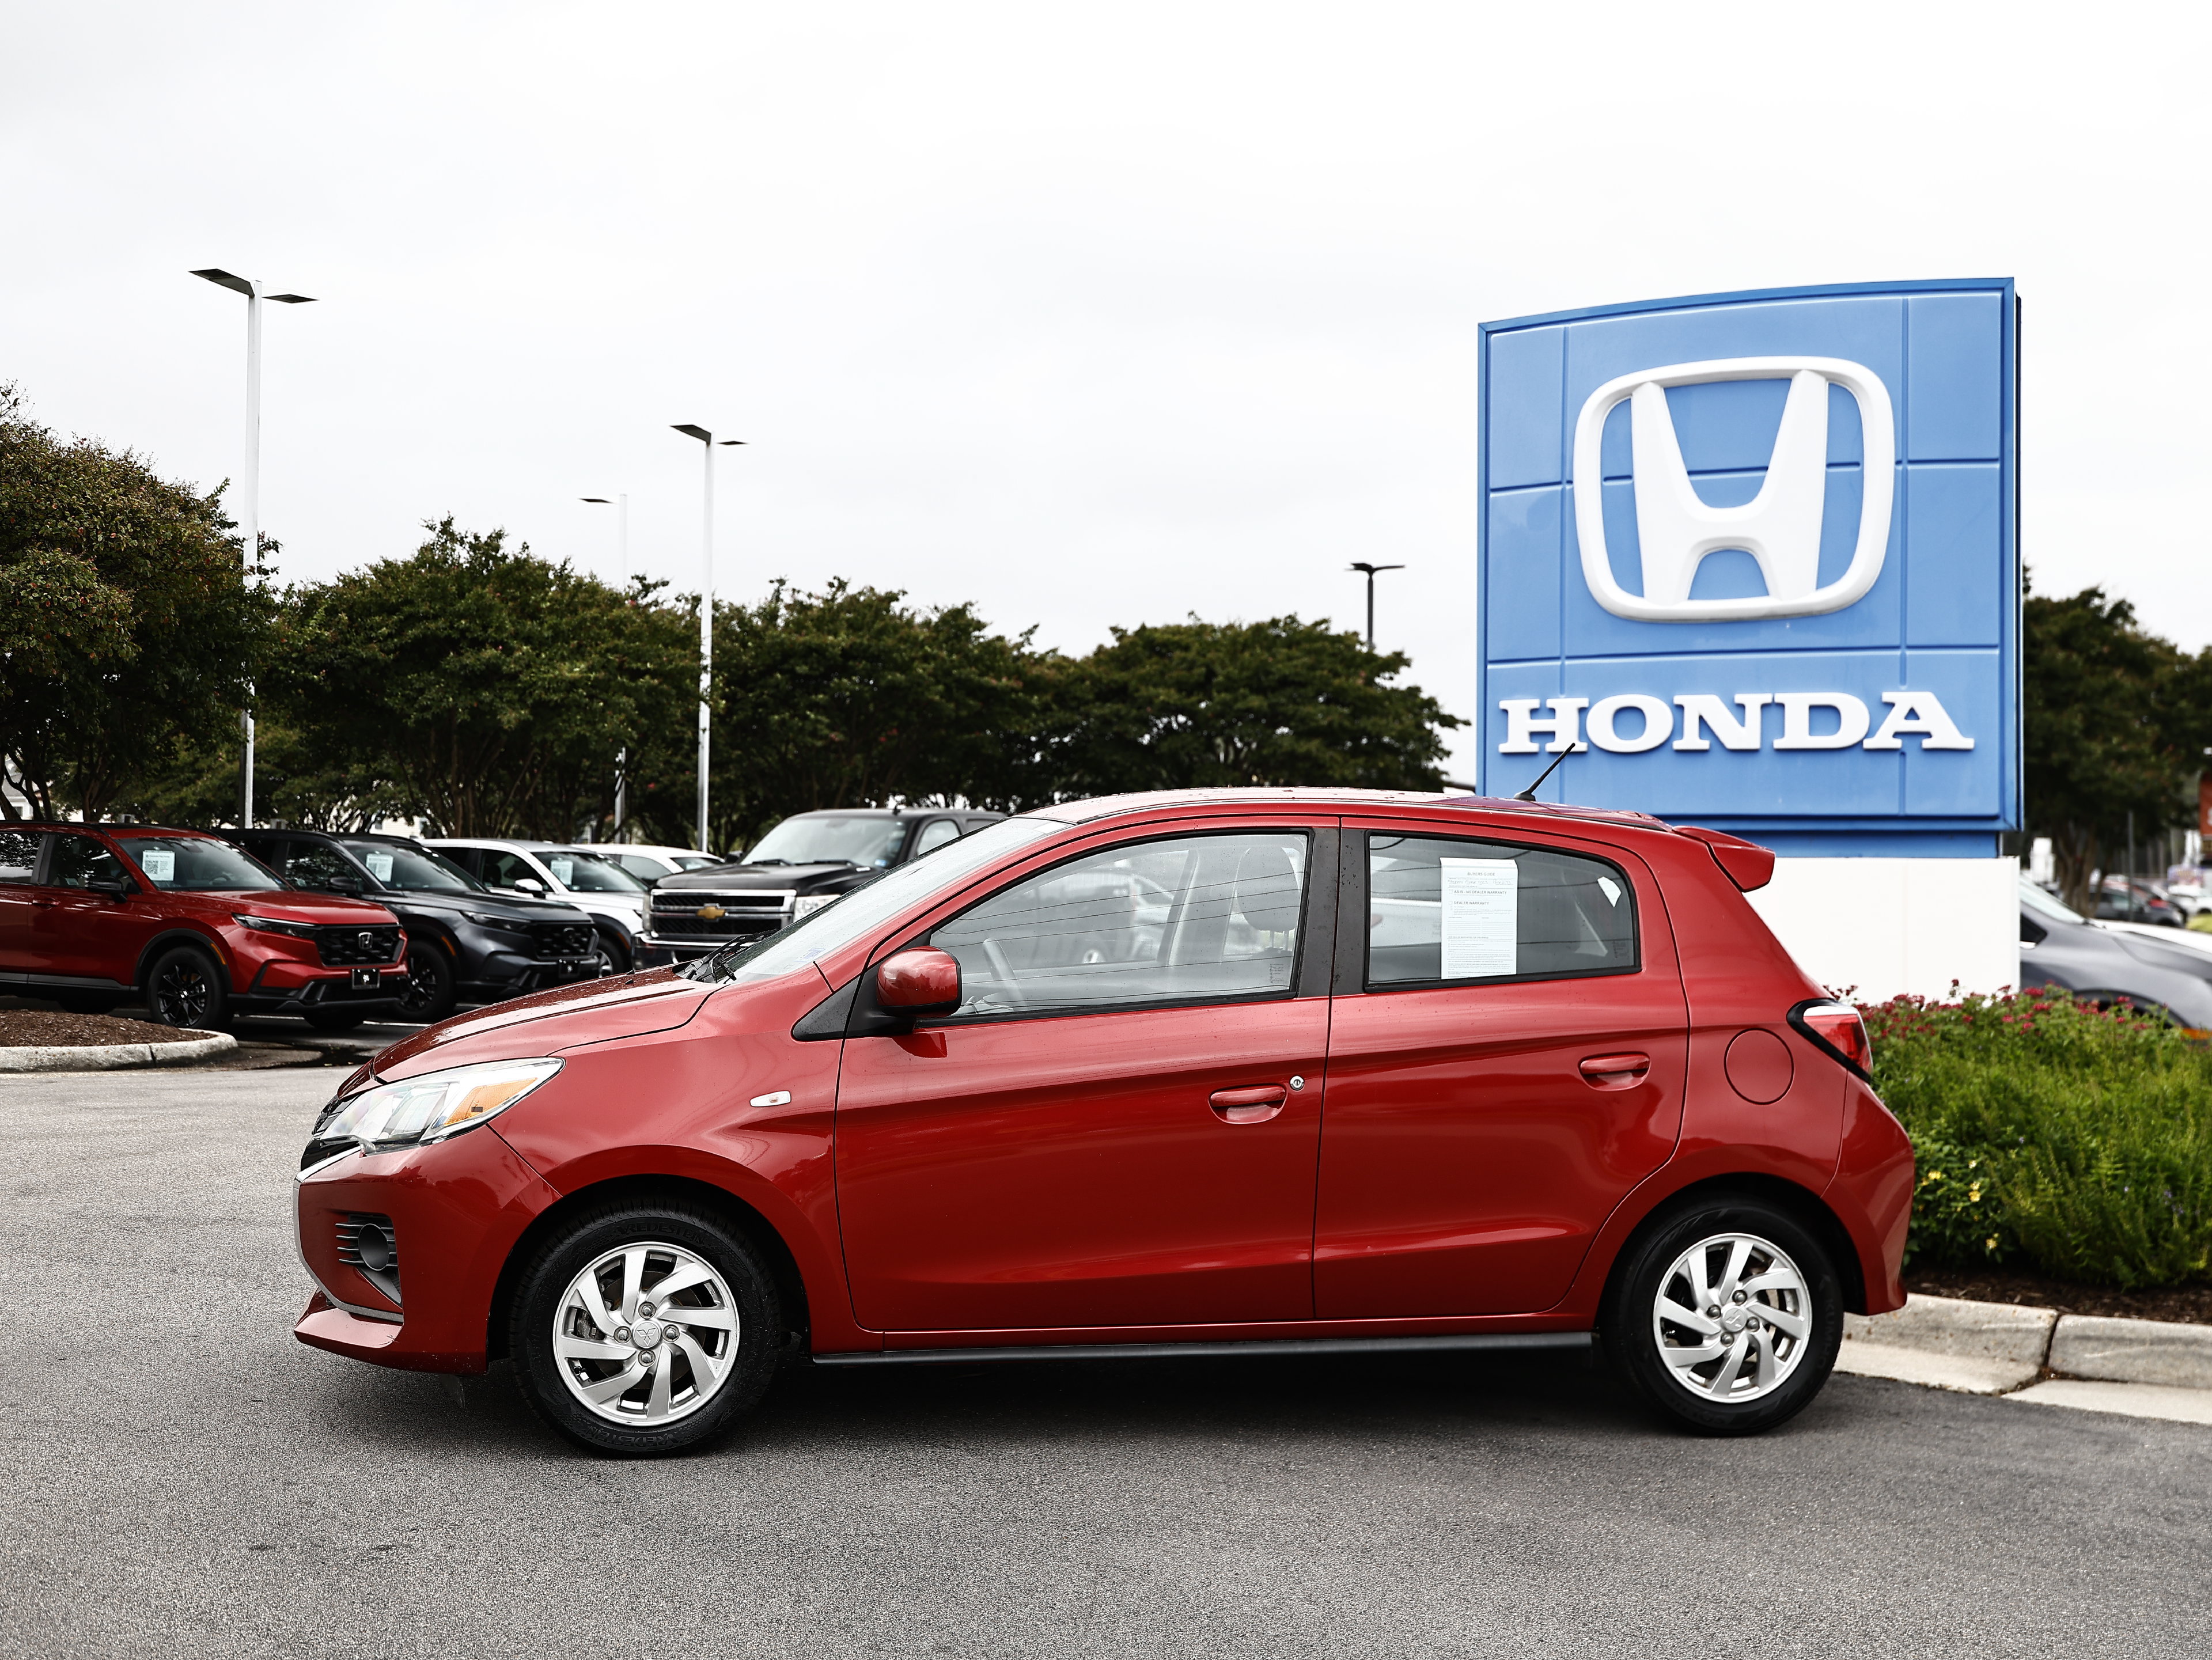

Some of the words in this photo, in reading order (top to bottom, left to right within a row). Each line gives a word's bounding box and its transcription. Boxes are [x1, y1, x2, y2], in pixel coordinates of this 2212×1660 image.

[1498, 691, 1975, 753] HONDA
[616, 1222, 706, 1245] VREDESTEIN
[585, 1425, 679, 1447] VREDESTEIN
